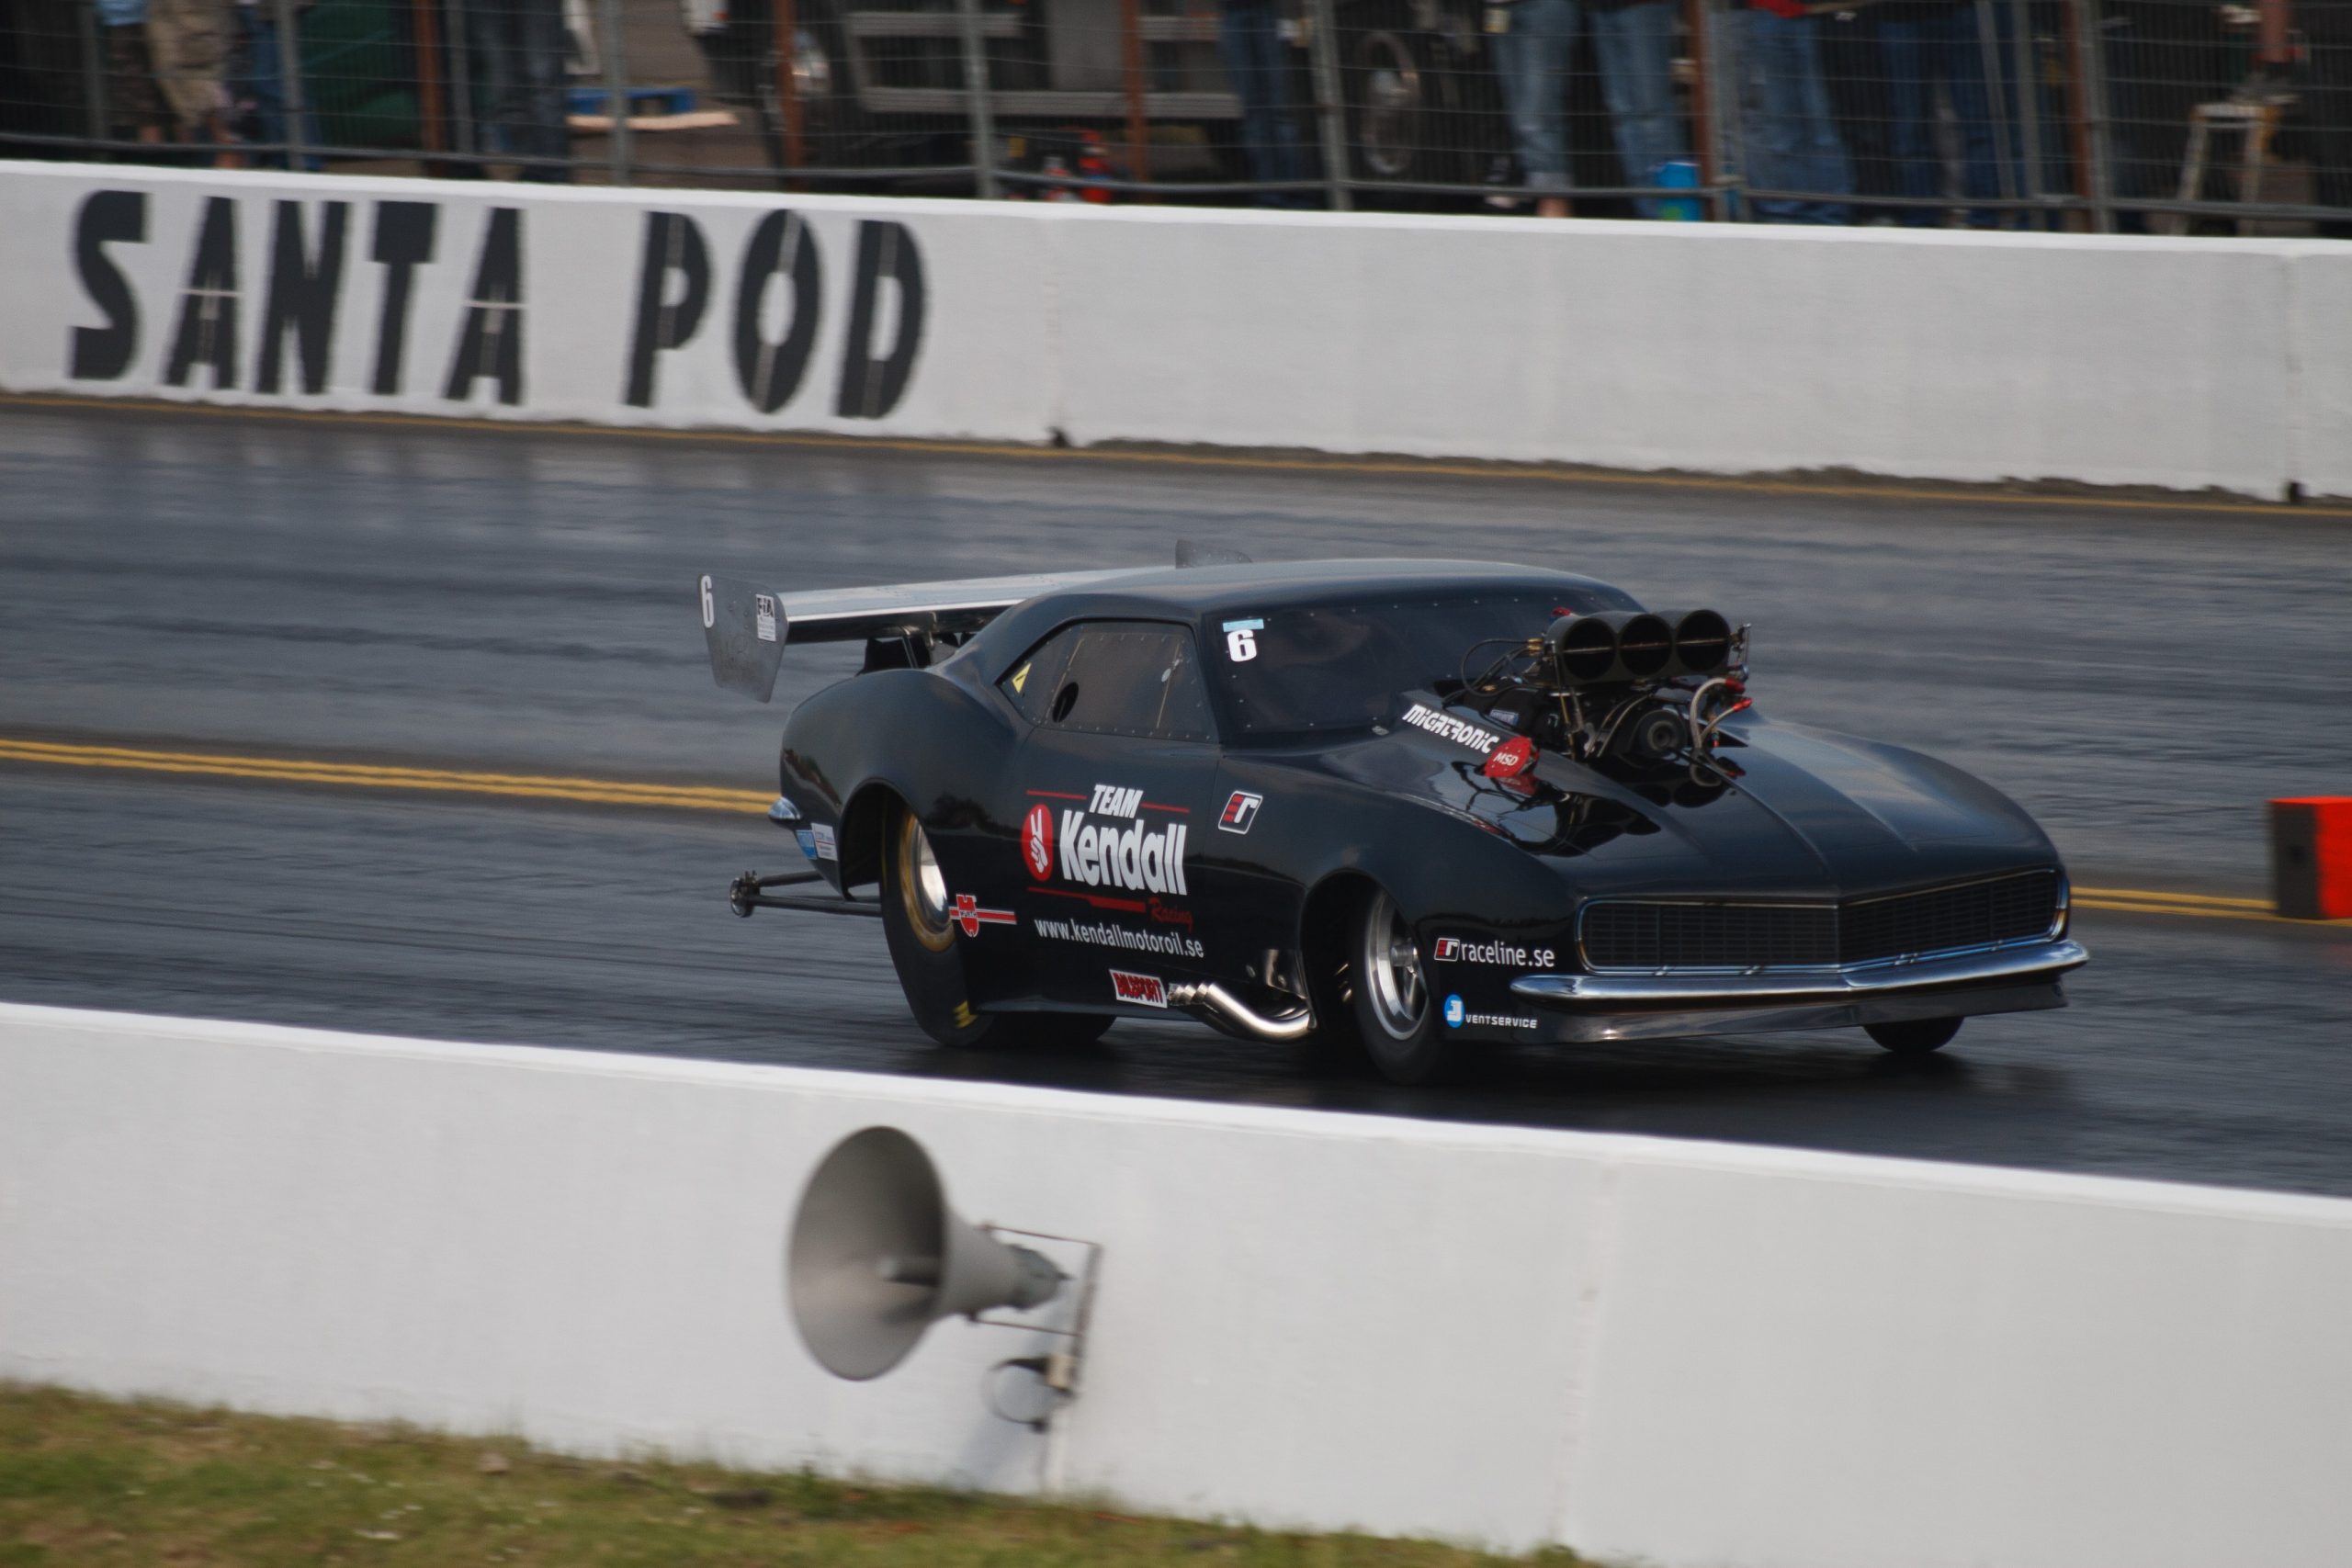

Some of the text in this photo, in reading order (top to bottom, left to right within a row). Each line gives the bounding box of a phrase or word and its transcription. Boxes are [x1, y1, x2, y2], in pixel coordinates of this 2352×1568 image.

[68, 189, 930, 418] SANTA POD
[701, 576, 714, 627] 6
[1227, 629, 1257, 662] 6
[1493, 751, 1519, 766] MSD
[1089, 784, 1144, 818] TEAM
[1059, 809, 1188, 896] Kendall
[1148, 897, 1193, 933] Racing
[1034, 919, 1204, 958] www.kendallmotoroil.se
[1461, 941, 1555, 966] raceline.se
[1465, 1014, 1537, 1029] VENTSERVICE
